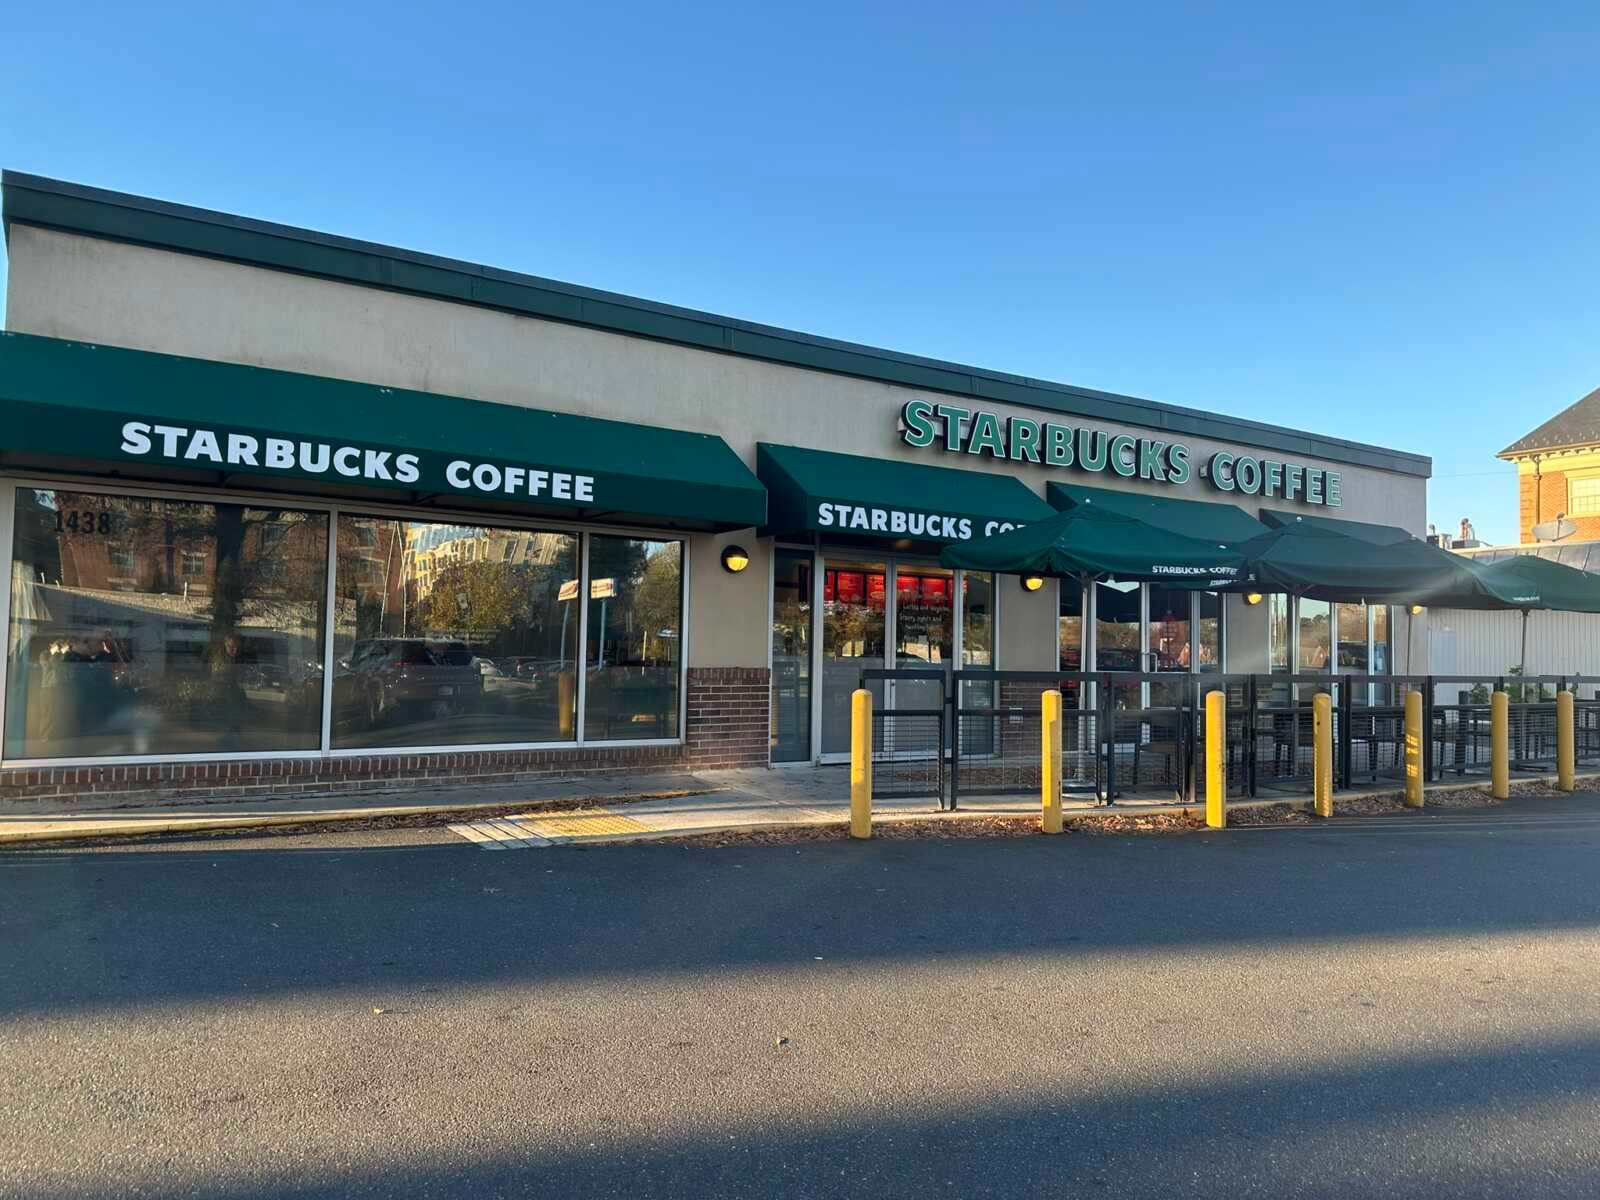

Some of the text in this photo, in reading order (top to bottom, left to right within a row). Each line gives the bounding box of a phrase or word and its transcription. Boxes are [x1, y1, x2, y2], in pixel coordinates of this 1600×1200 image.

[120, 421, 595, 502] STARBUCKS COFFEE
[902, 400, 1343, 507] STARBUCKS COFFEE
[54, 511, 111, 535] 1438
[818, 502, 972, 540] STARBUCKS
